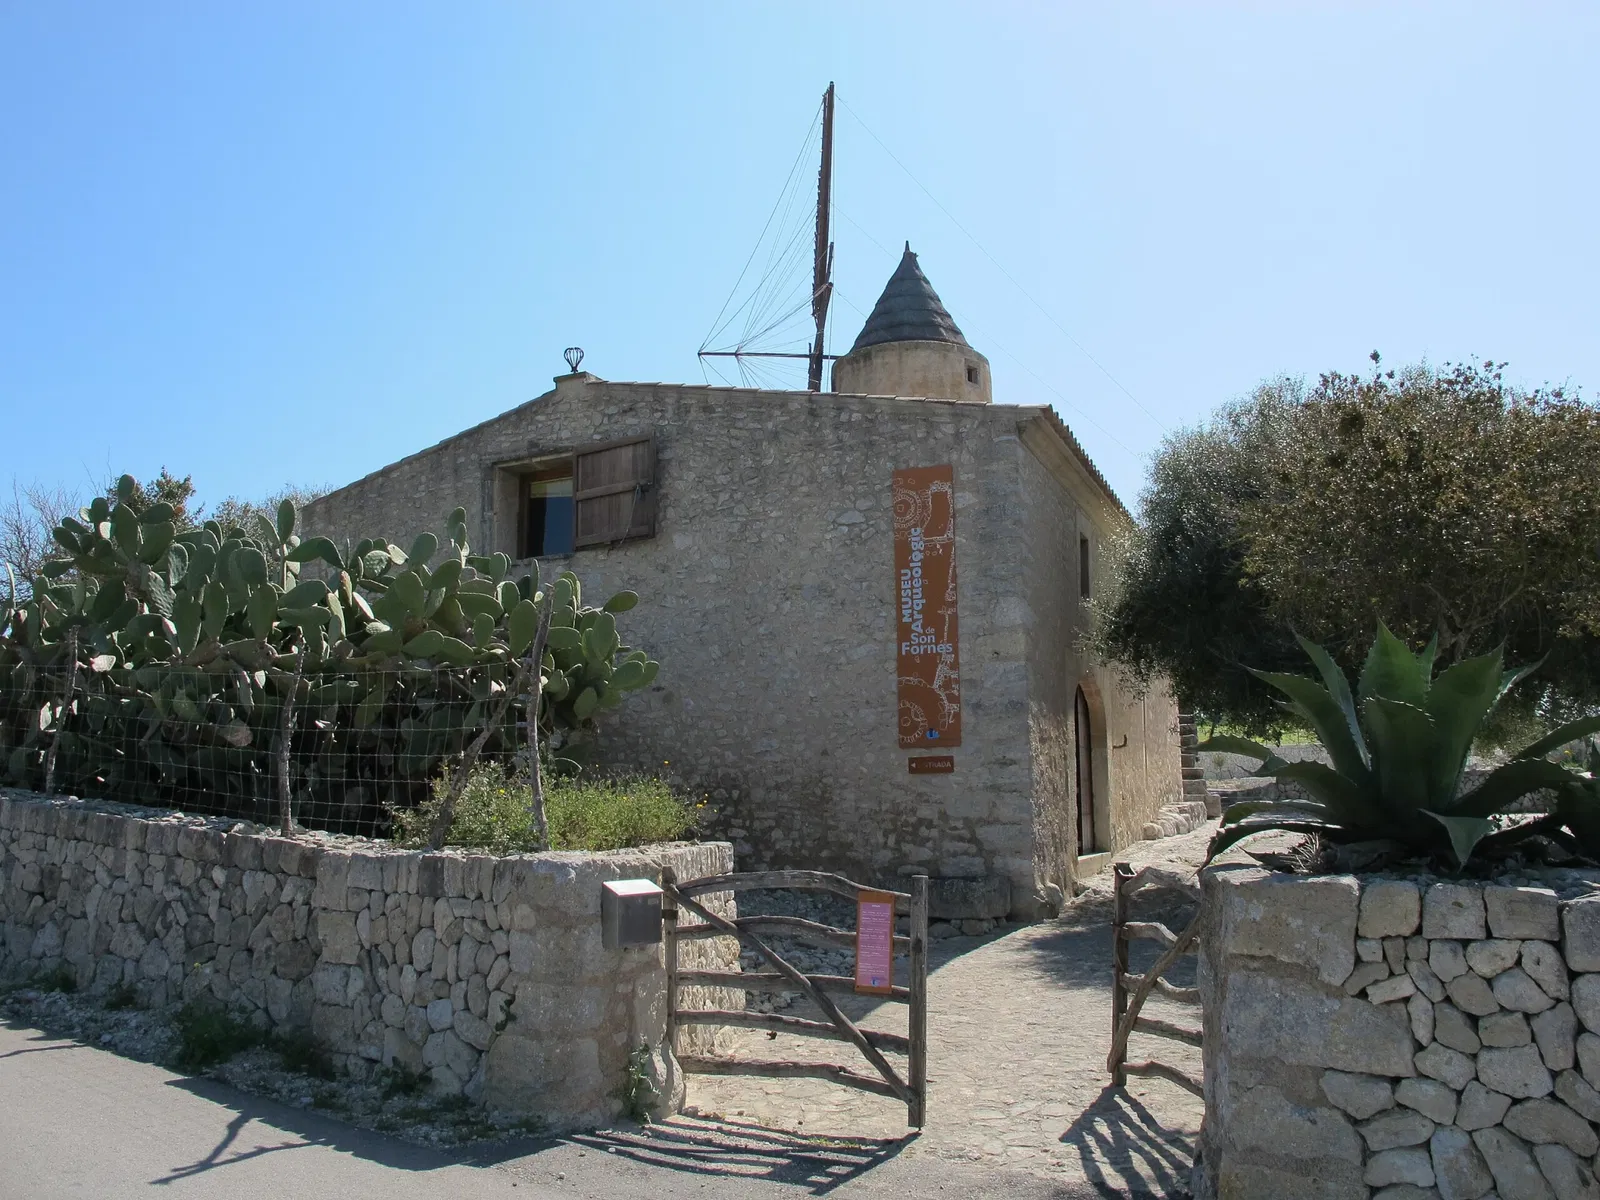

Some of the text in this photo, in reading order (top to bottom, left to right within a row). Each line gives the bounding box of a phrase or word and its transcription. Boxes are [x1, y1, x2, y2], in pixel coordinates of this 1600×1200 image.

[901, 569, 912, 622] MUSEU
[925, 626, 935, 634] de
[911, 633, 935, 645] Son
